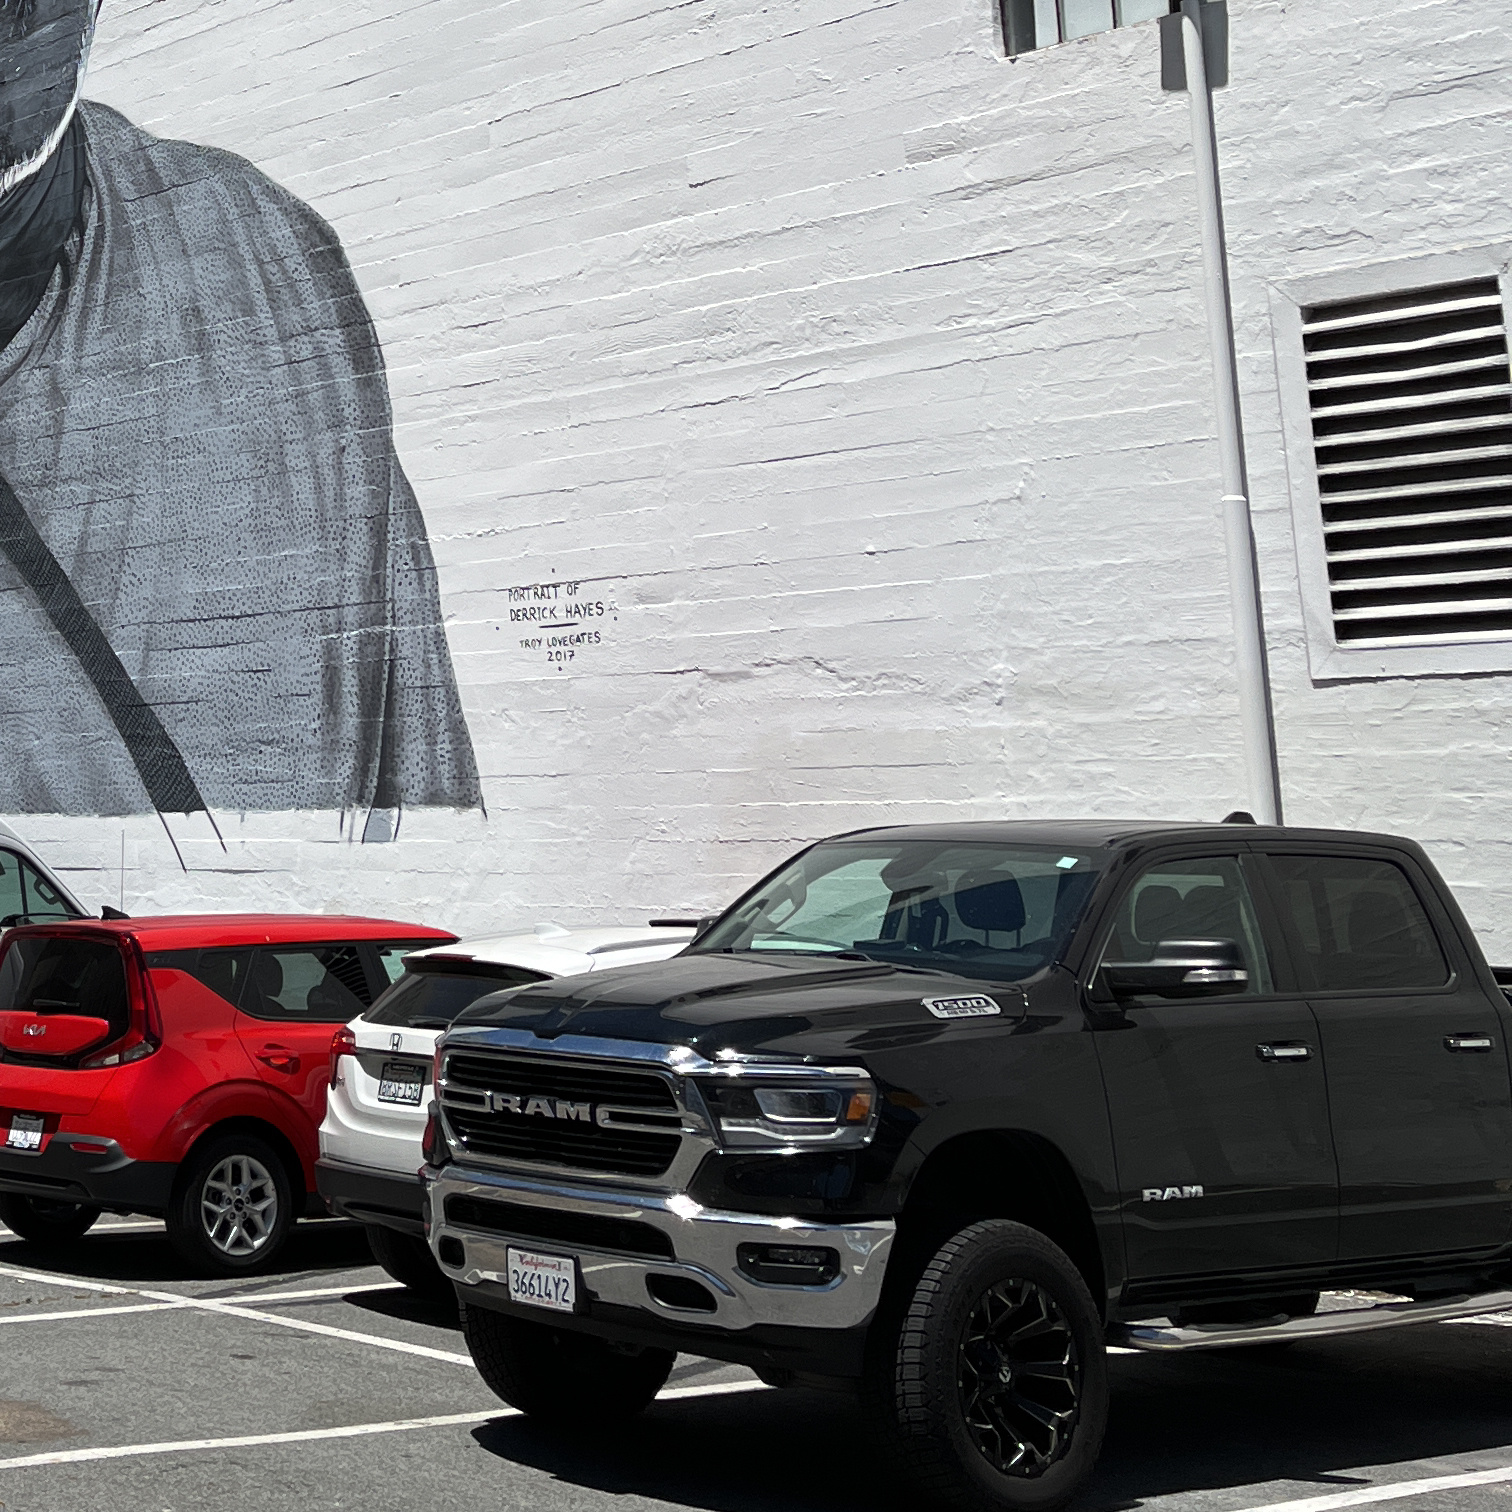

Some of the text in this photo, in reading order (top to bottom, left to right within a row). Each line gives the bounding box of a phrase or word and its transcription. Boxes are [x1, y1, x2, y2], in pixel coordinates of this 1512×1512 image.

[508, 583, 580, 602] PORTRAIT OF
[510, 601, 604, 621] DERRICK HAYES
[519, 631, 601, 649] TROY LOVEGATES
[547, 650, 575, 662] 2017
[933, 998, 987, 1011] 1500
[492, 1092, 591, 1122] RAM
[1142, 1185, 1204, 1202] RAM
[512, 1269, 570, 1303] 36614Y2
